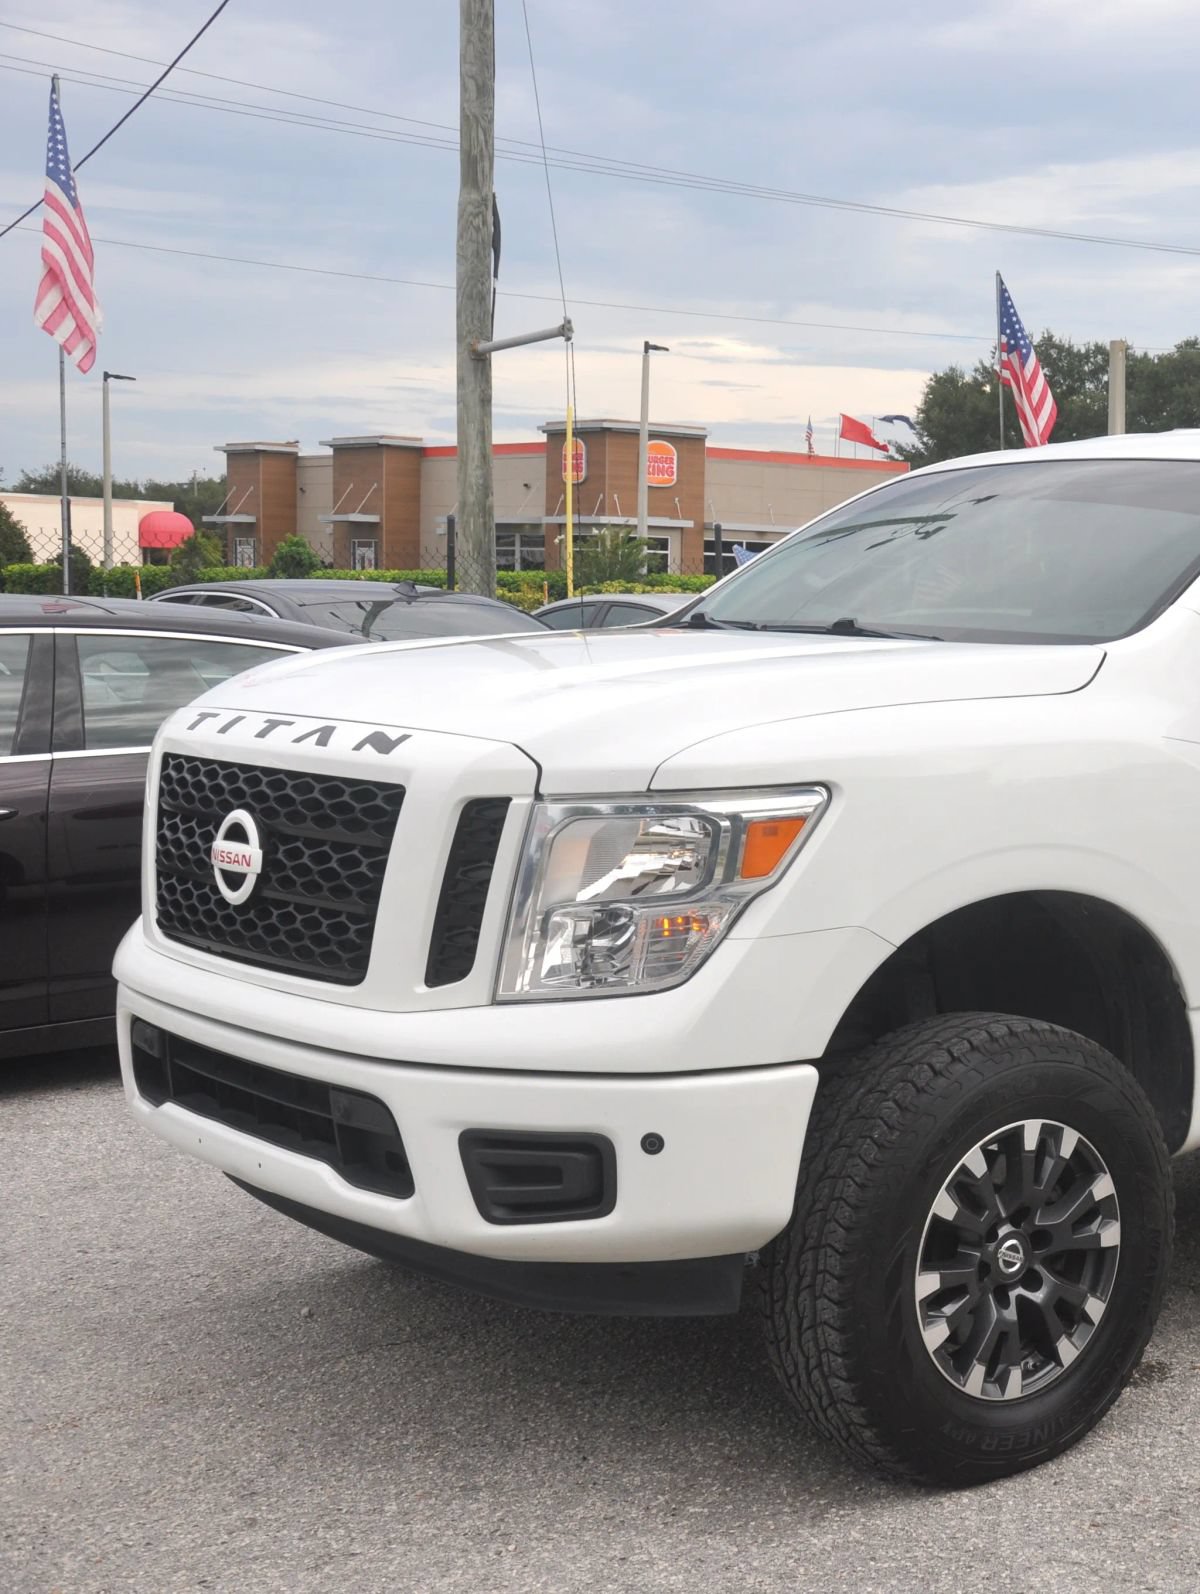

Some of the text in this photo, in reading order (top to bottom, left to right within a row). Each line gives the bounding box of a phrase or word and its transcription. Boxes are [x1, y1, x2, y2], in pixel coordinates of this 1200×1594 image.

[647, 456, 675, 465] URGER
[186, 712, 413, 755] TITAN
[212, 848, 252, 868] NISSAN
